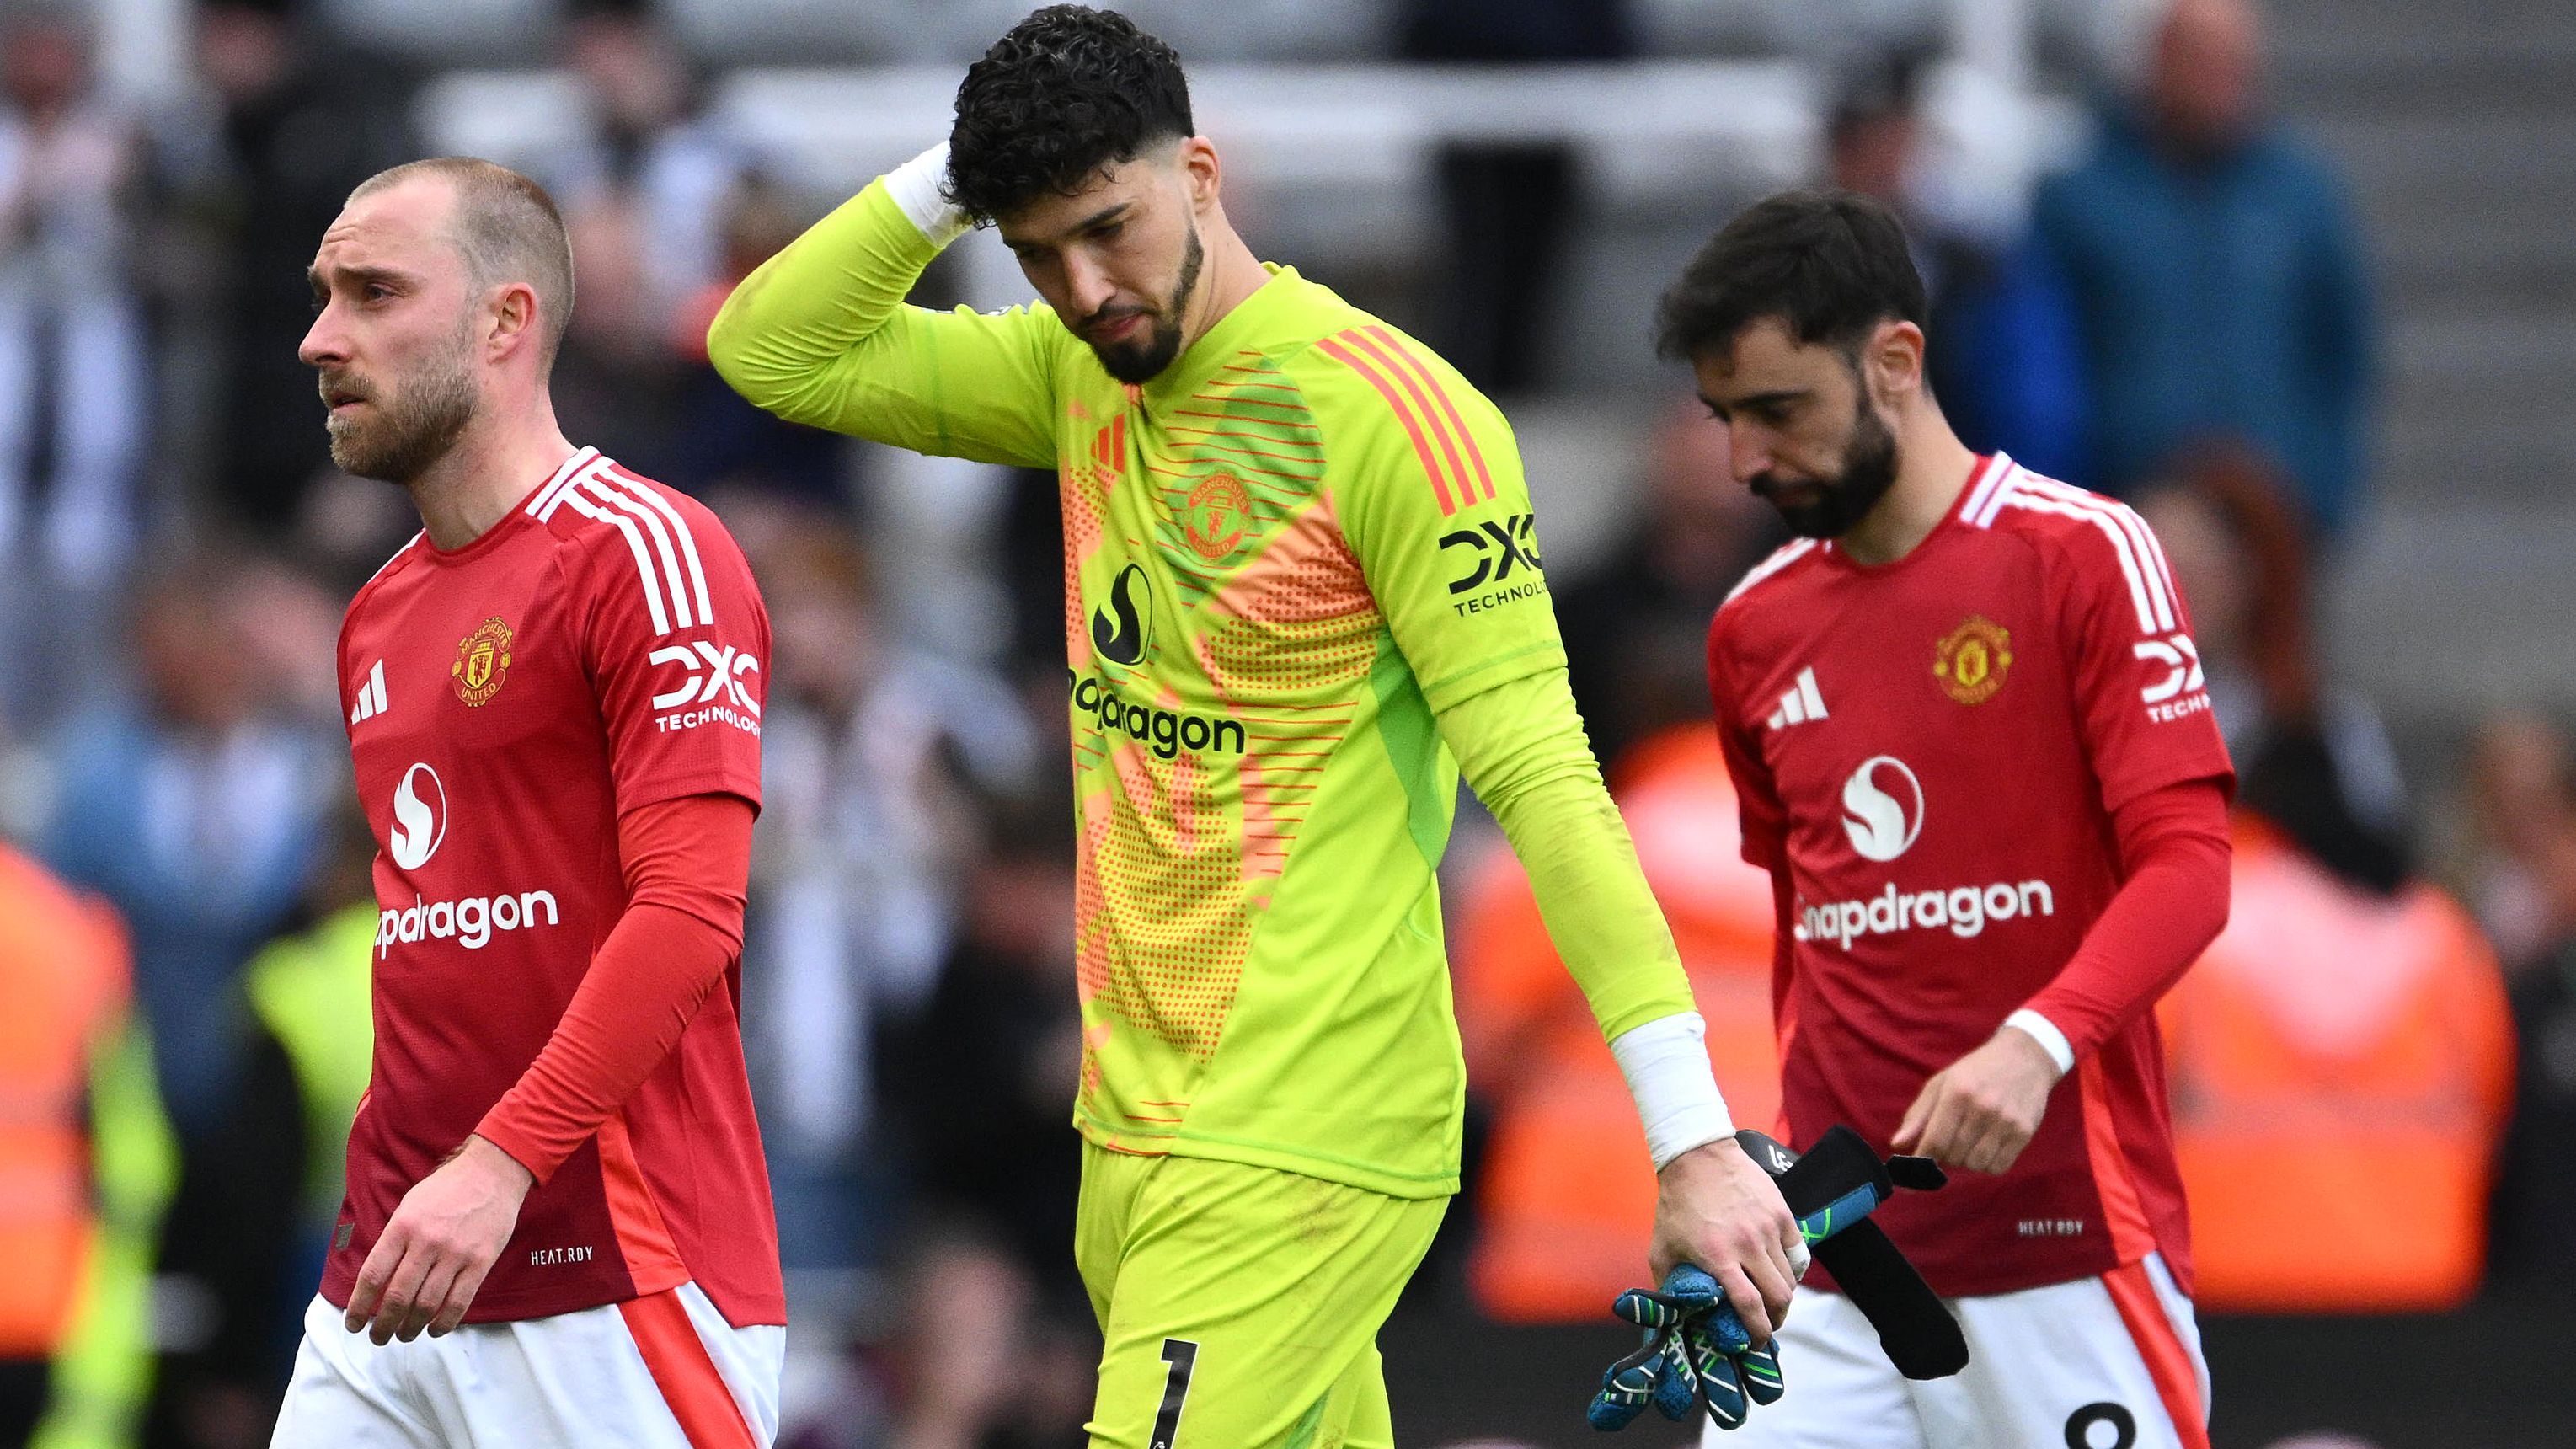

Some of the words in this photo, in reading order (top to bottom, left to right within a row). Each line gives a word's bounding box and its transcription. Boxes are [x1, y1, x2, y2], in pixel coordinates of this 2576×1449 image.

[1439, 514, 1542, 595] DXC
[458, 623, 509, 654] MANCHESTER
[461, 682, 496, 701] UNITED
[649, 640, 761, 719] DXC
[2018, 1220, 2084, 1235] HEATRDY
[531, 1246, 593, 1266] HEAT.RDY
[1148, 1337, 1200, 1449] 1
